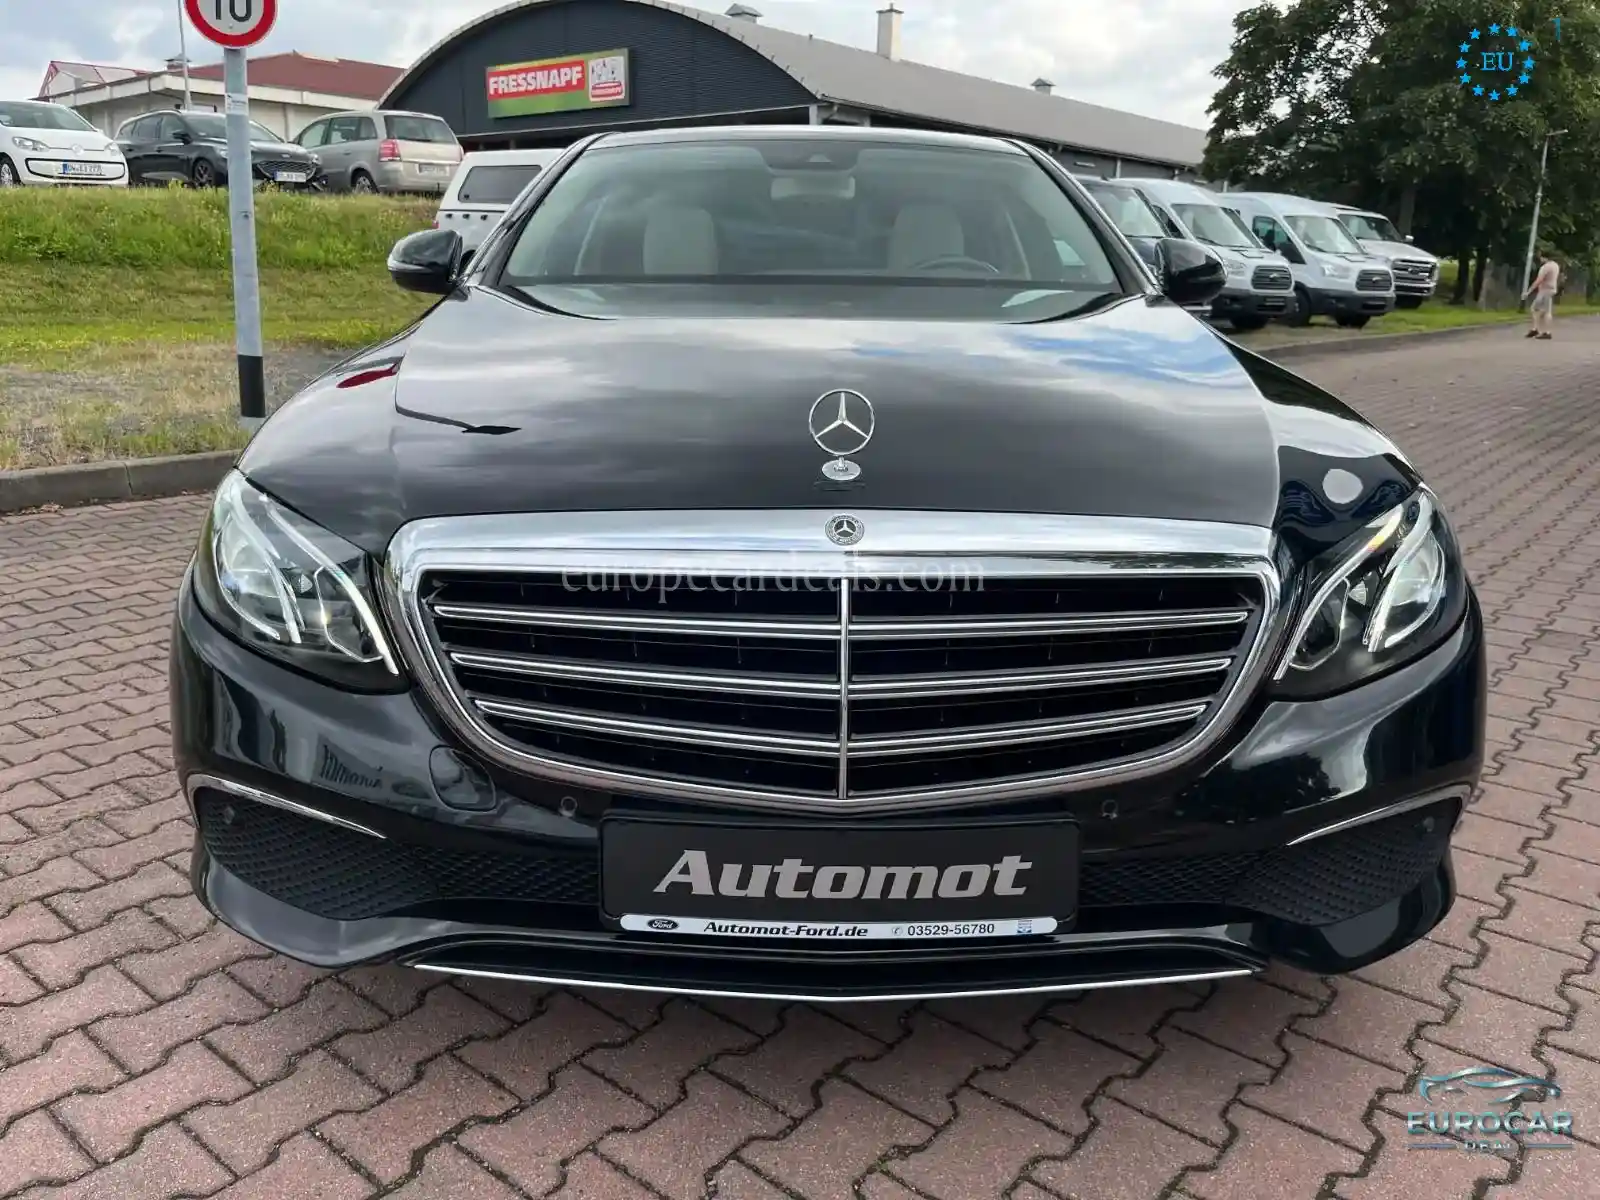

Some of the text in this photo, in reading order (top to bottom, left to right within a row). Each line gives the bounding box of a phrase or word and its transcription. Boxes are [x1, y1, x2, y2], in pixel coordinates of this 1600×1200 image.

[489, 66, 584, 96] FRESSNAPF
[653, 849, 1032, 900] Automot
[652, 919, 674, 929] Ford
[703, 921, 995, 938] Automot-Ford.de 03529-56780
